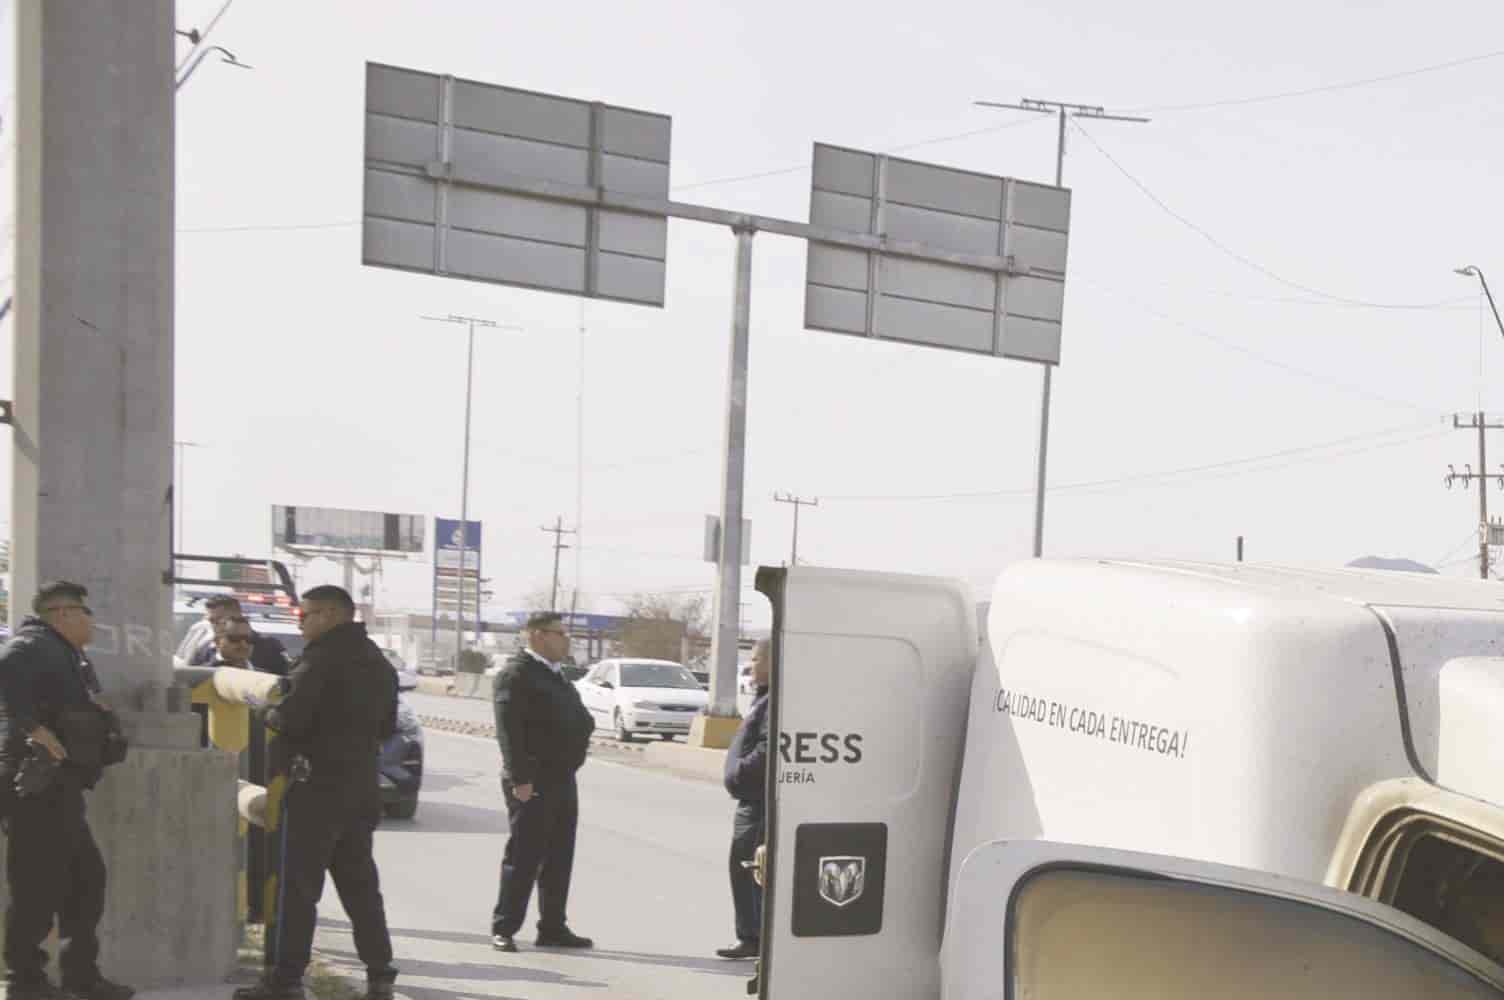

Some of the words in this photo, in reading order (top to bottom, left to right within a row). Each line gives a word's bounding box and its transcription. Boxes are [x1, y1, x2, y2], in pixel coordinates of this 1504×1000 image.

[1049, 702, 1067, 729] EN
[1069, 707, 1105, 739] CADA
[1108, 717, 1188, 759] ENTREGA!
